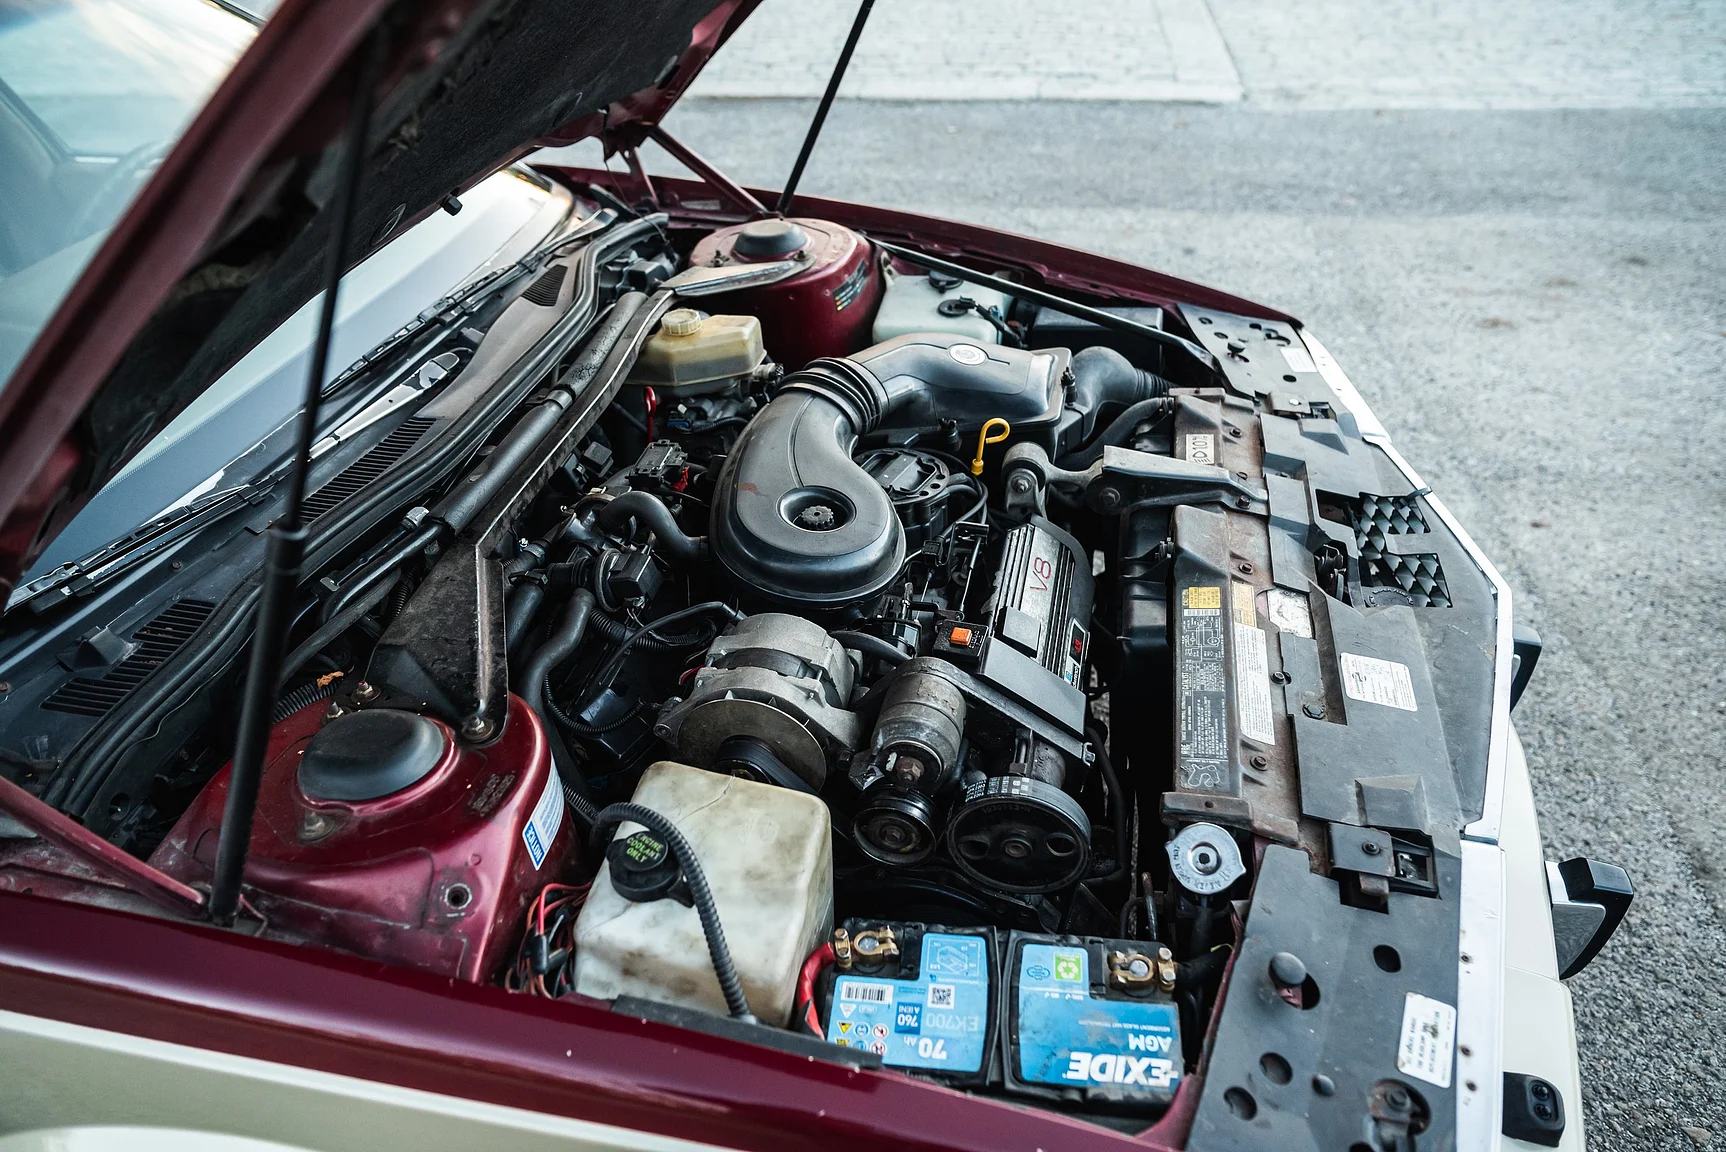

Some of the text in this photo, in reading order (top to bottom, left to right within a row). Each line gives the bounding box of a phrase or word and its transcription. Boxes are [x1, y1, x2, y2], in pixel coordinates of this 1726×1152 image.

[1030, 556, 1052, 592] V8
[526, 826, 544, 862] NOTICE
[626, 837, 661, 860] COOLANT
[636, 833, 664, 852] ENGINE
[626, 848, 647, 863] ONLY
[897, 1014, 918, 1027] 760
[926, 1013, 979, 1031] EK700
[904, 1036, 947, 1060] 70 Ah
[1128, 1034, 1172, 1052] AGM
[1068, 1051, 1178, 1087] EXIDE
